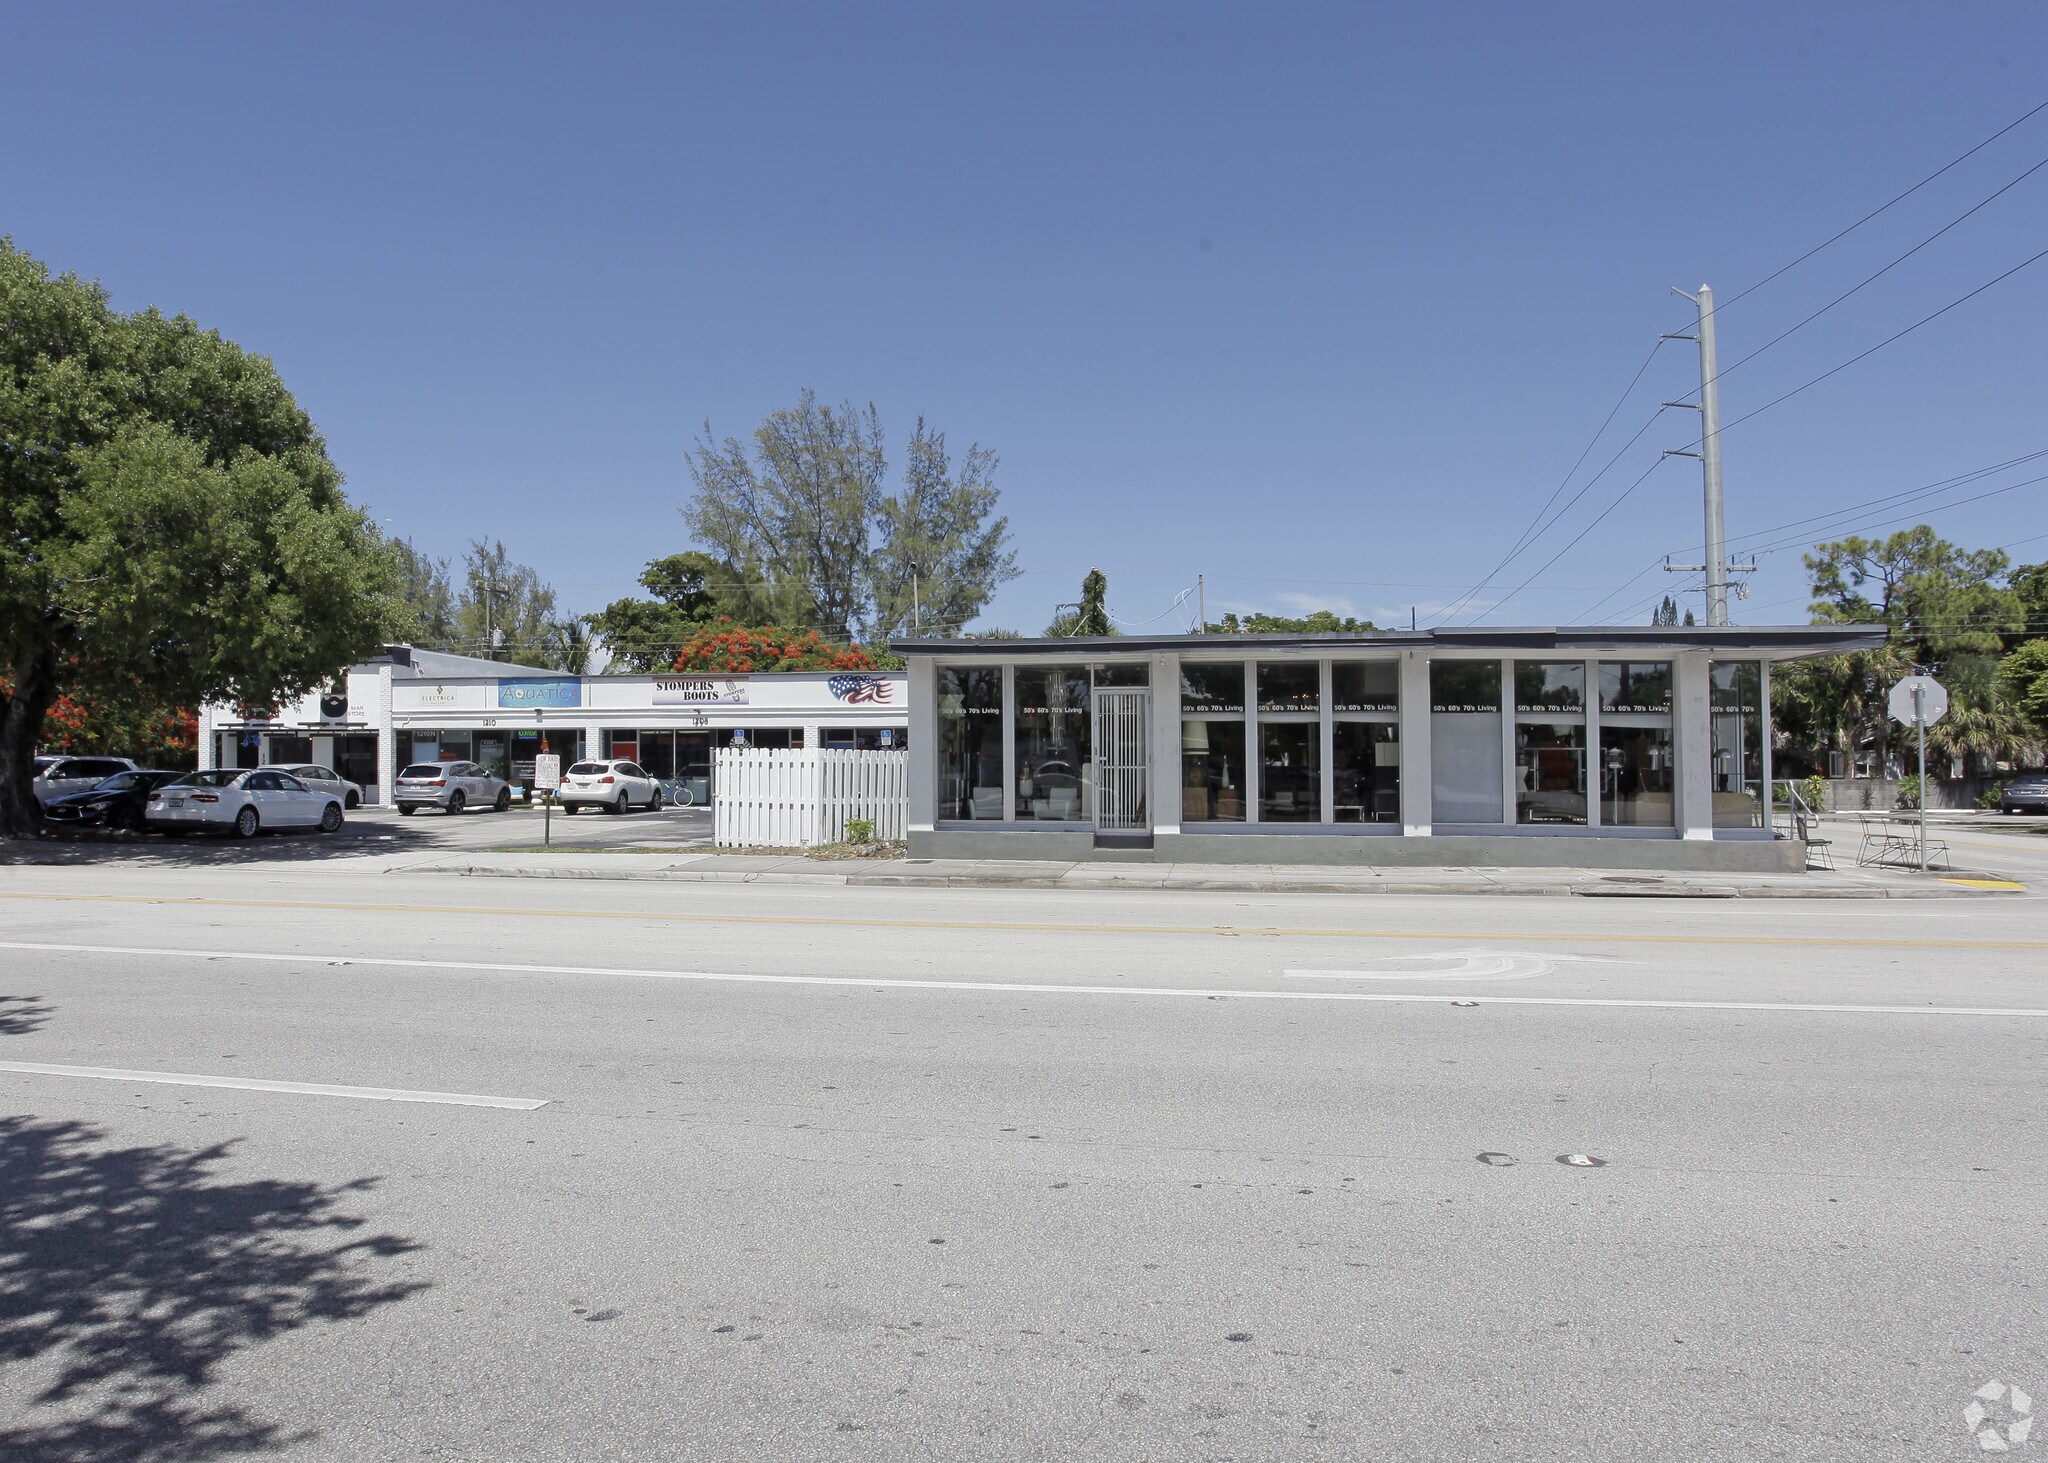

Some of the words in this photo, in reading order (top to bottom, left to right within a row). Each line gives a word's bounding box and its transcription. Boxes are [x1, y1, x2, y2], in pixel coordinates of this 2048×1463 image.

[656, 681, 714, 691] STOMPERS
[502, 686, 579, 700] AQUATICA
[683, 691, 719, 701] BOOTS
[1065, 707, 1082, 715] Living
[1378, 704, 1396, 712] Living
[1478, 705, 1496, 713] Living
[1563, 705, 1582, 713] Living
[1648, 705, 1668, 713] Living
